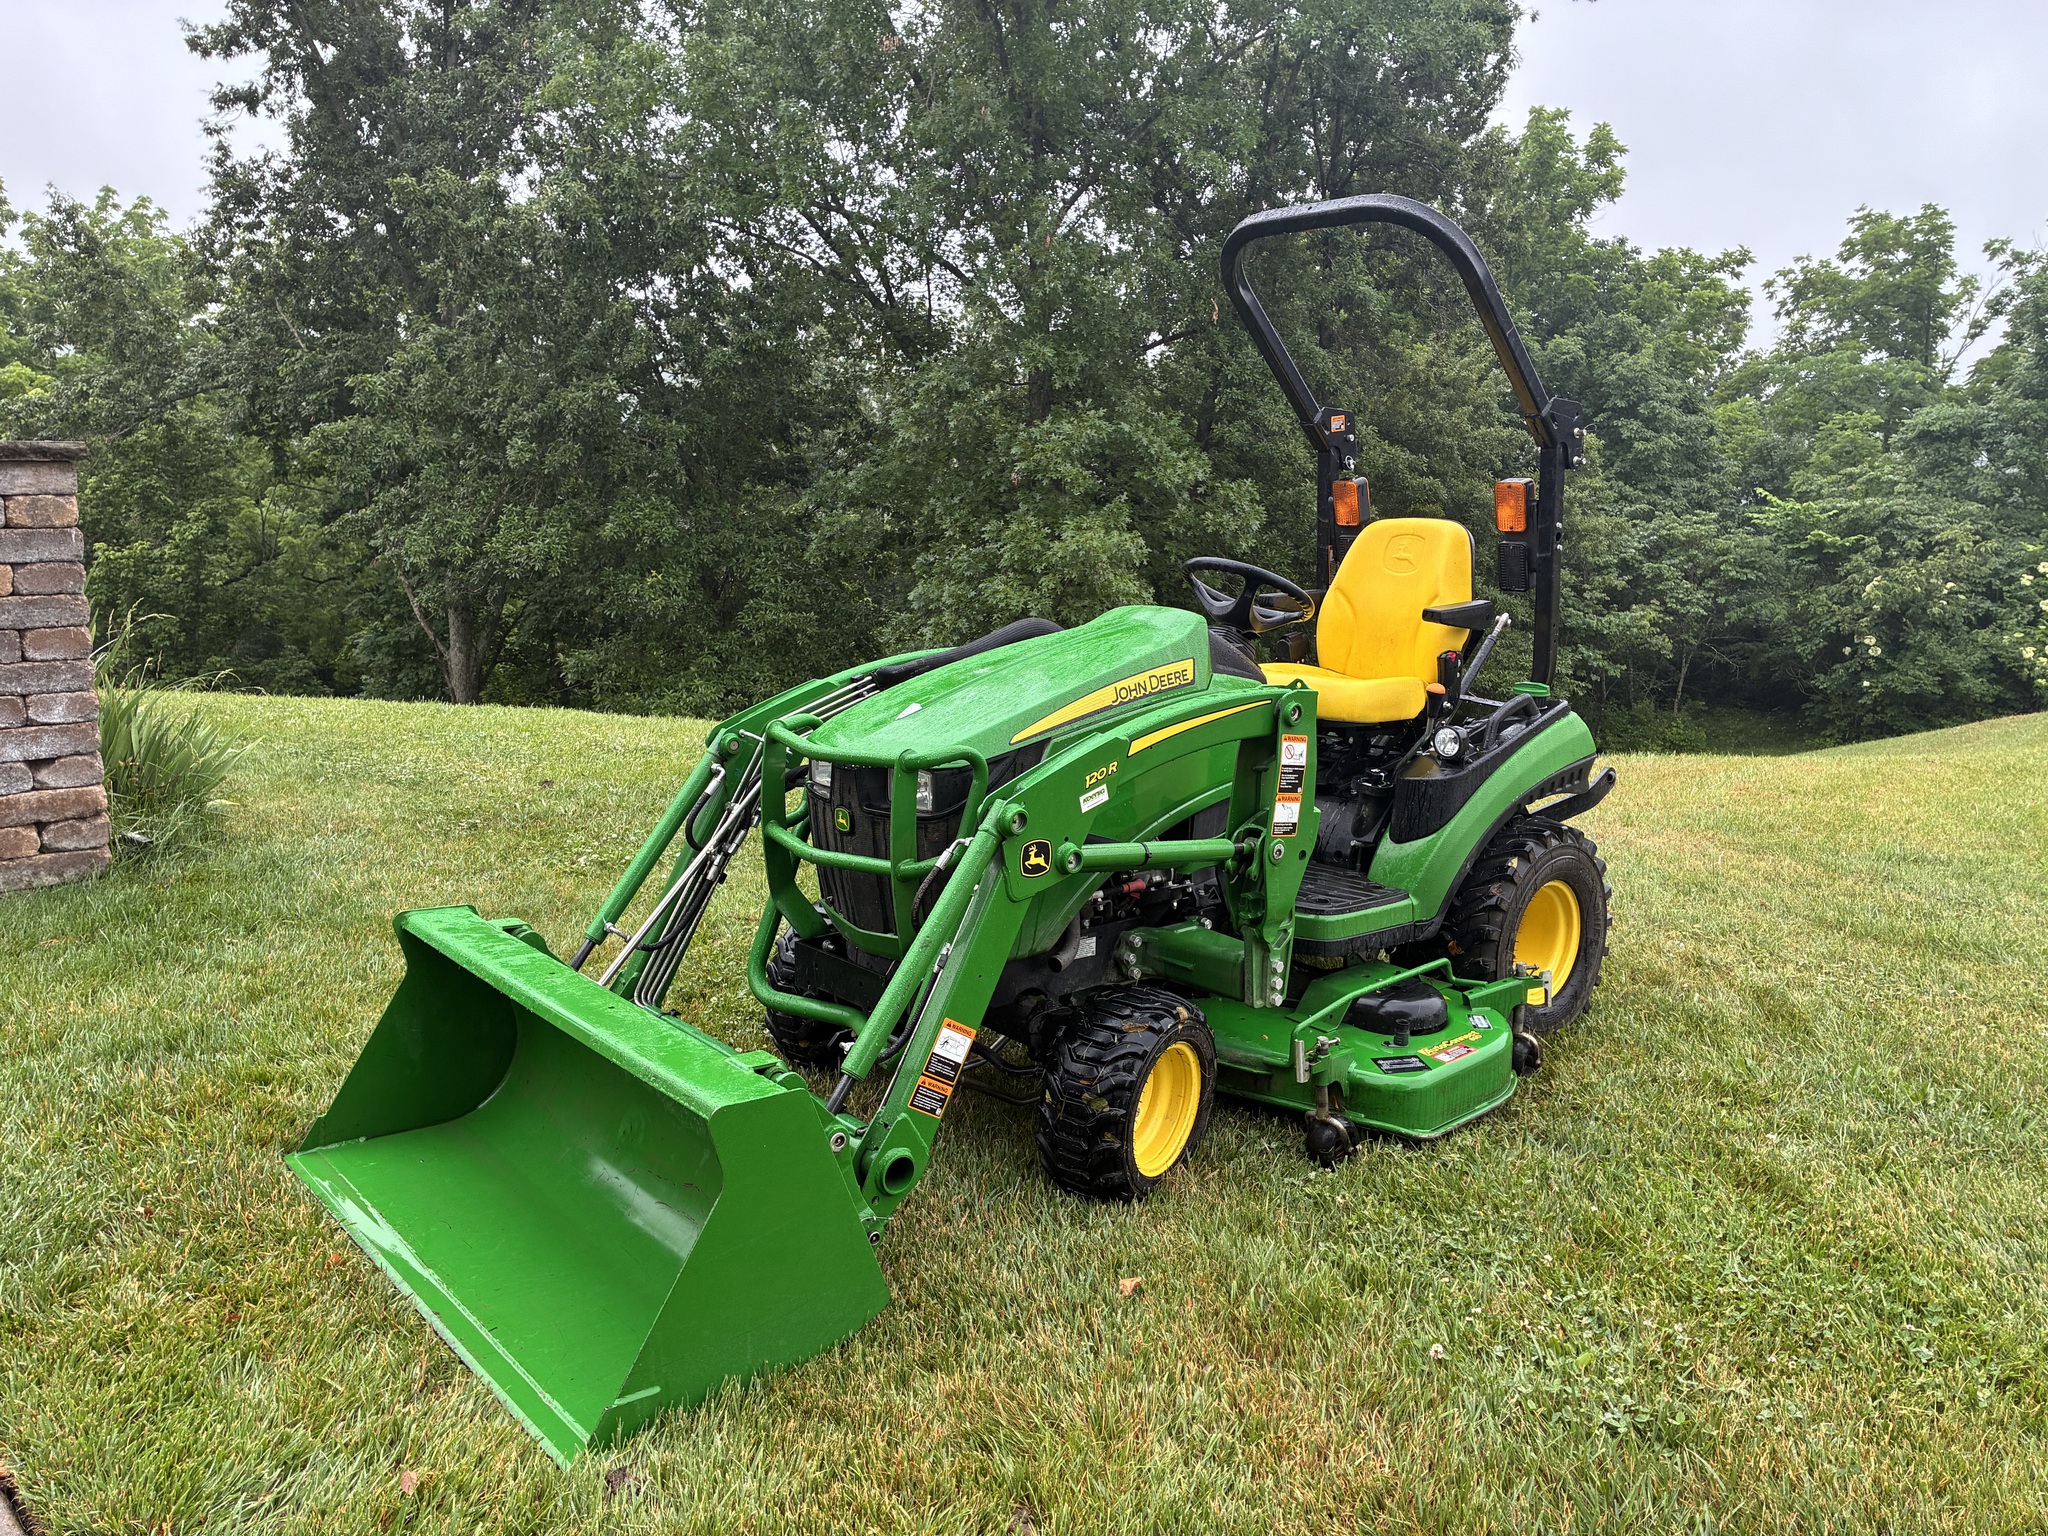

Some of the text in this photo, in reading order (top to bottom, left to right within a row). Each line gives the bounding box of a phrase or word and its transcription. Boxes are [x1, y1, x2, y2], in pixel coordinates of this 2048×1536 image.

[1111, 669, 1190, 704] JOHN DEERE
[1085, 761, 1119, 789] 120 R
[952, 1023, 973, 1036] WARNING
[927, 1080, 949, 1094] WARNING
